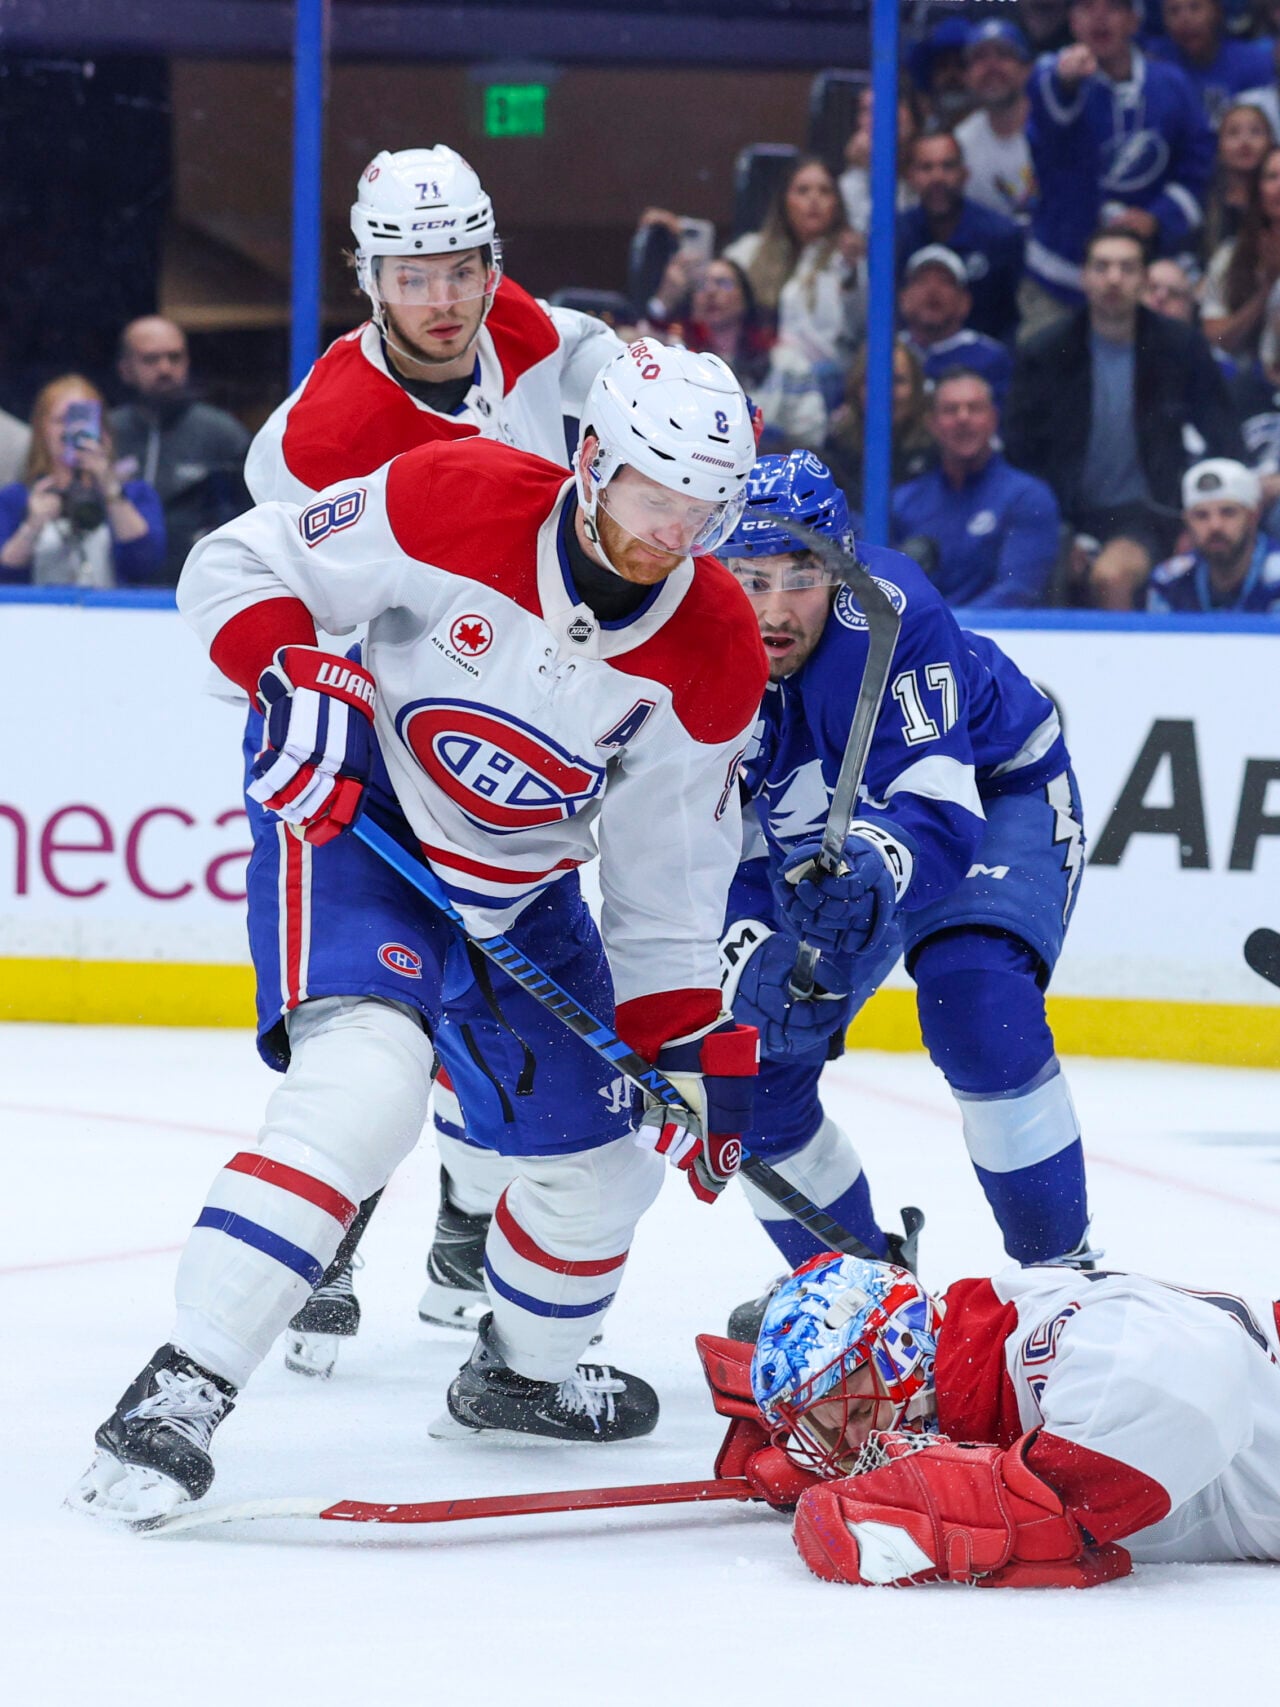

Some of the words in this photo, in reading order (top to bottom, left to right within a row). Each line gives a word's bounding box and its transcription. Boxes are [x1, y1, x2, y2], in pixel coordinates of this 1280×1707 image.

[415, 181, 442, 200] 71
[411, 219, 457, 231] CCM
[714, 410, 729, 434] 8
[690, 452, 736, 470] WARRIOR
[298, 487, 367, 549] 8
[741, 519, 778, 531] CC
[842, 608, 869, 626] AMPA
[431, 637, 445, 651] AIR
[444, 649, 480, 678] CANADA
[891, 662, 959, 747] 17
[595, 699, 657, 749] A
